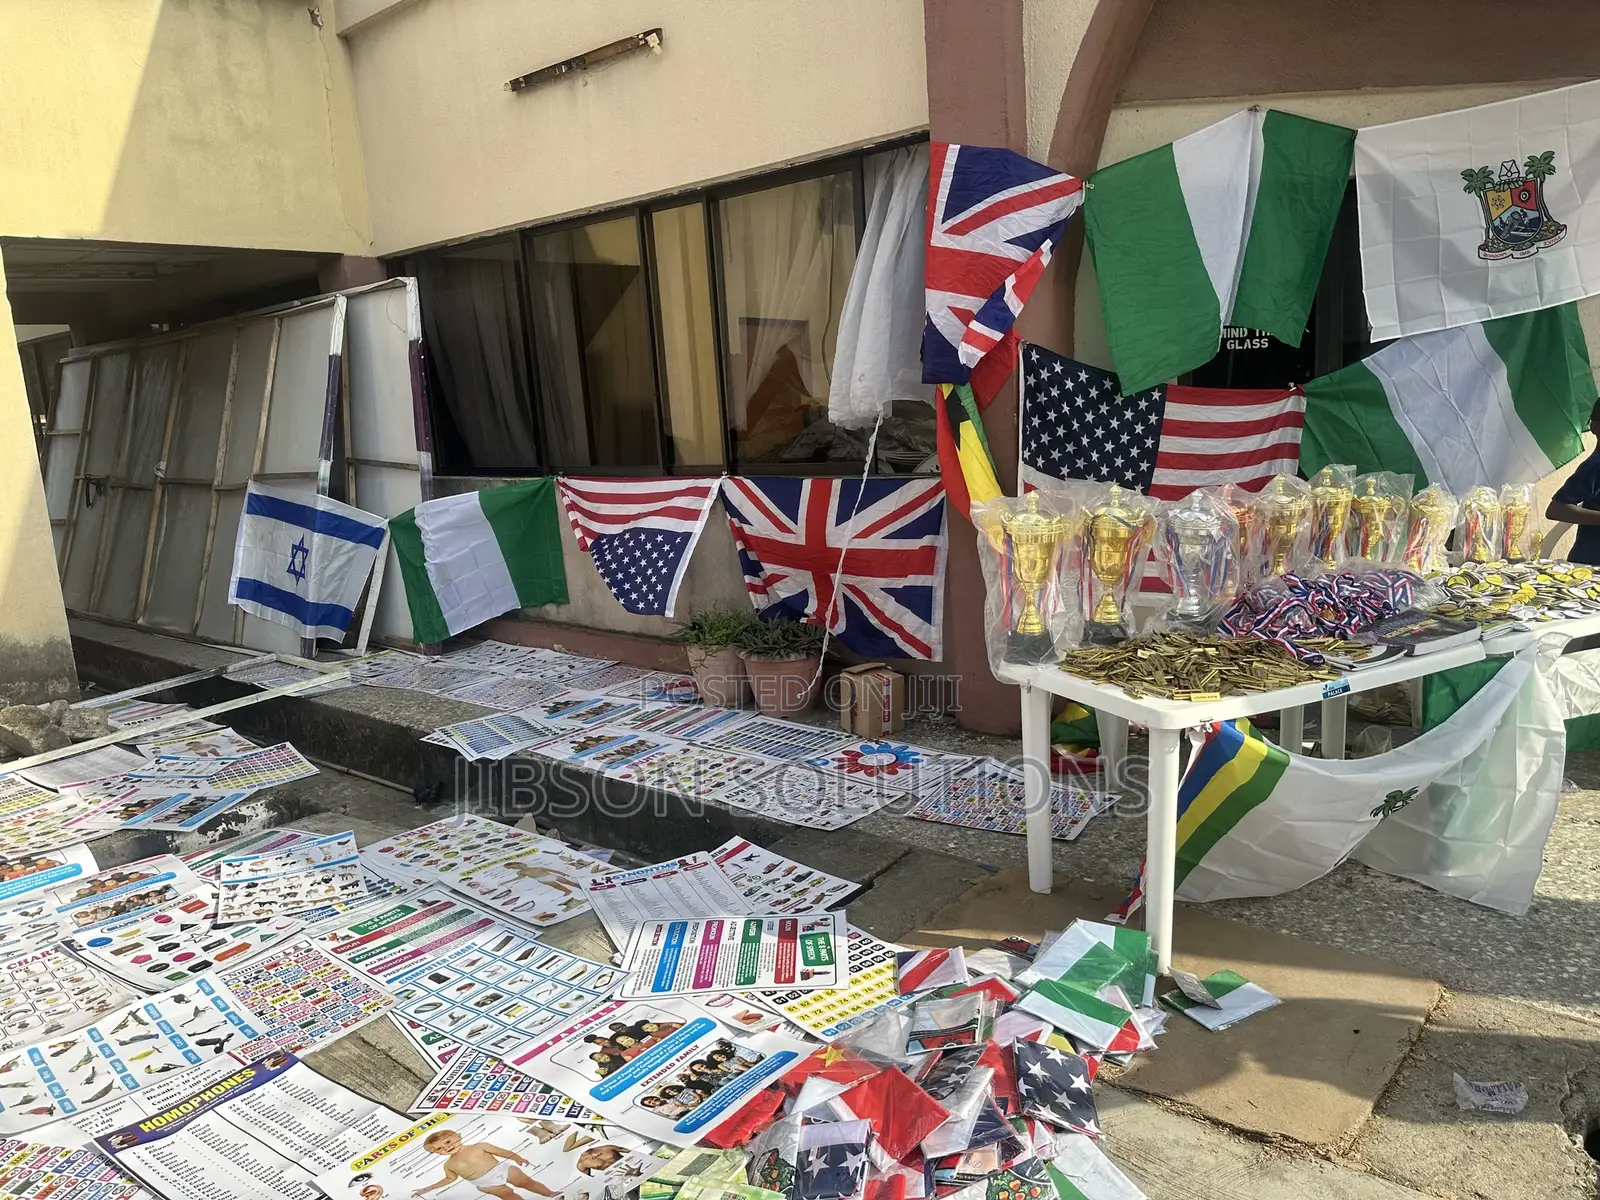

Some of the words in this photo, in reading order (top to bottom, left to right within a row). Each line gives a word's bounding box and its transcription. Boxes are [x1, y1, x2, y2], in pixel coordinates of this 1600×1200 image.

[1226, 338, 1269, 350] GLASS
[392, 821, 446, 841] FRUITS
[611, 861, 678, 881] SYNONYMS
[107, 917, 140, 932] SHAPES
[140, 911, 159, 923] AND
[380, 911, 405, 926] SPEECH
[381, 908, 401, 920] PARTS
[708, 921, 718, 940] PRONOUN
[728, 921, 737, 941] ADJECTIVE
[748, 921, 756, 937] ADVERB
[767, 920, 775, 931] VERB
[337, 941, 361, 952] NOUN
[354, 946, 388, 962] ADVERB
[806, 945, 816, 960] SPEECH
[818, 949, 829, 961] PARTS
[7, 945, 61, 970] CHART
[365, 947, 408, 967] ADJECTIVE
[373, 953, 413, 973] PRONOUN
[400, 956, 448, 985] COMPUTER
[449, 941, 479, 960] CHART
[383, 956, 428, 978] PREPOSITION
[566, 1025, 595, 1043] NUCLEAR
[595, 1014, 617, 1029] FAMILY
[440, 1057, 466, 1087] Roman
[640, 1061, 675, 1088] EXTENDED
[675, 1044, 700, 1063] FAMILY
[156, 1079, 174, 1090] days
[450, 1097, 461, 1108] VII
[483, 1063, 491, 1071] IX
[139, 1068, 257, 1132] HOMOPHONES
[146, 1086, 175, 1101] Decade
[151, 1090, 182, 1107] Century
[101, 1099, 127, 1113] Minute
[104, 1107, 123, 1117] hour
[94, 1123, 115, 1134] week
[100, 1117, 114, 1126] day
[352, 1113, 377, 1130] Through
[367, 1125, 388, 1139] Weight
[353, 1142, 398, 1170] PARTS
[398, 1129, 416, 1143] OF
[416, 1116, 446, 1131] THE
[27, 1184, 43, 1195] LIX
